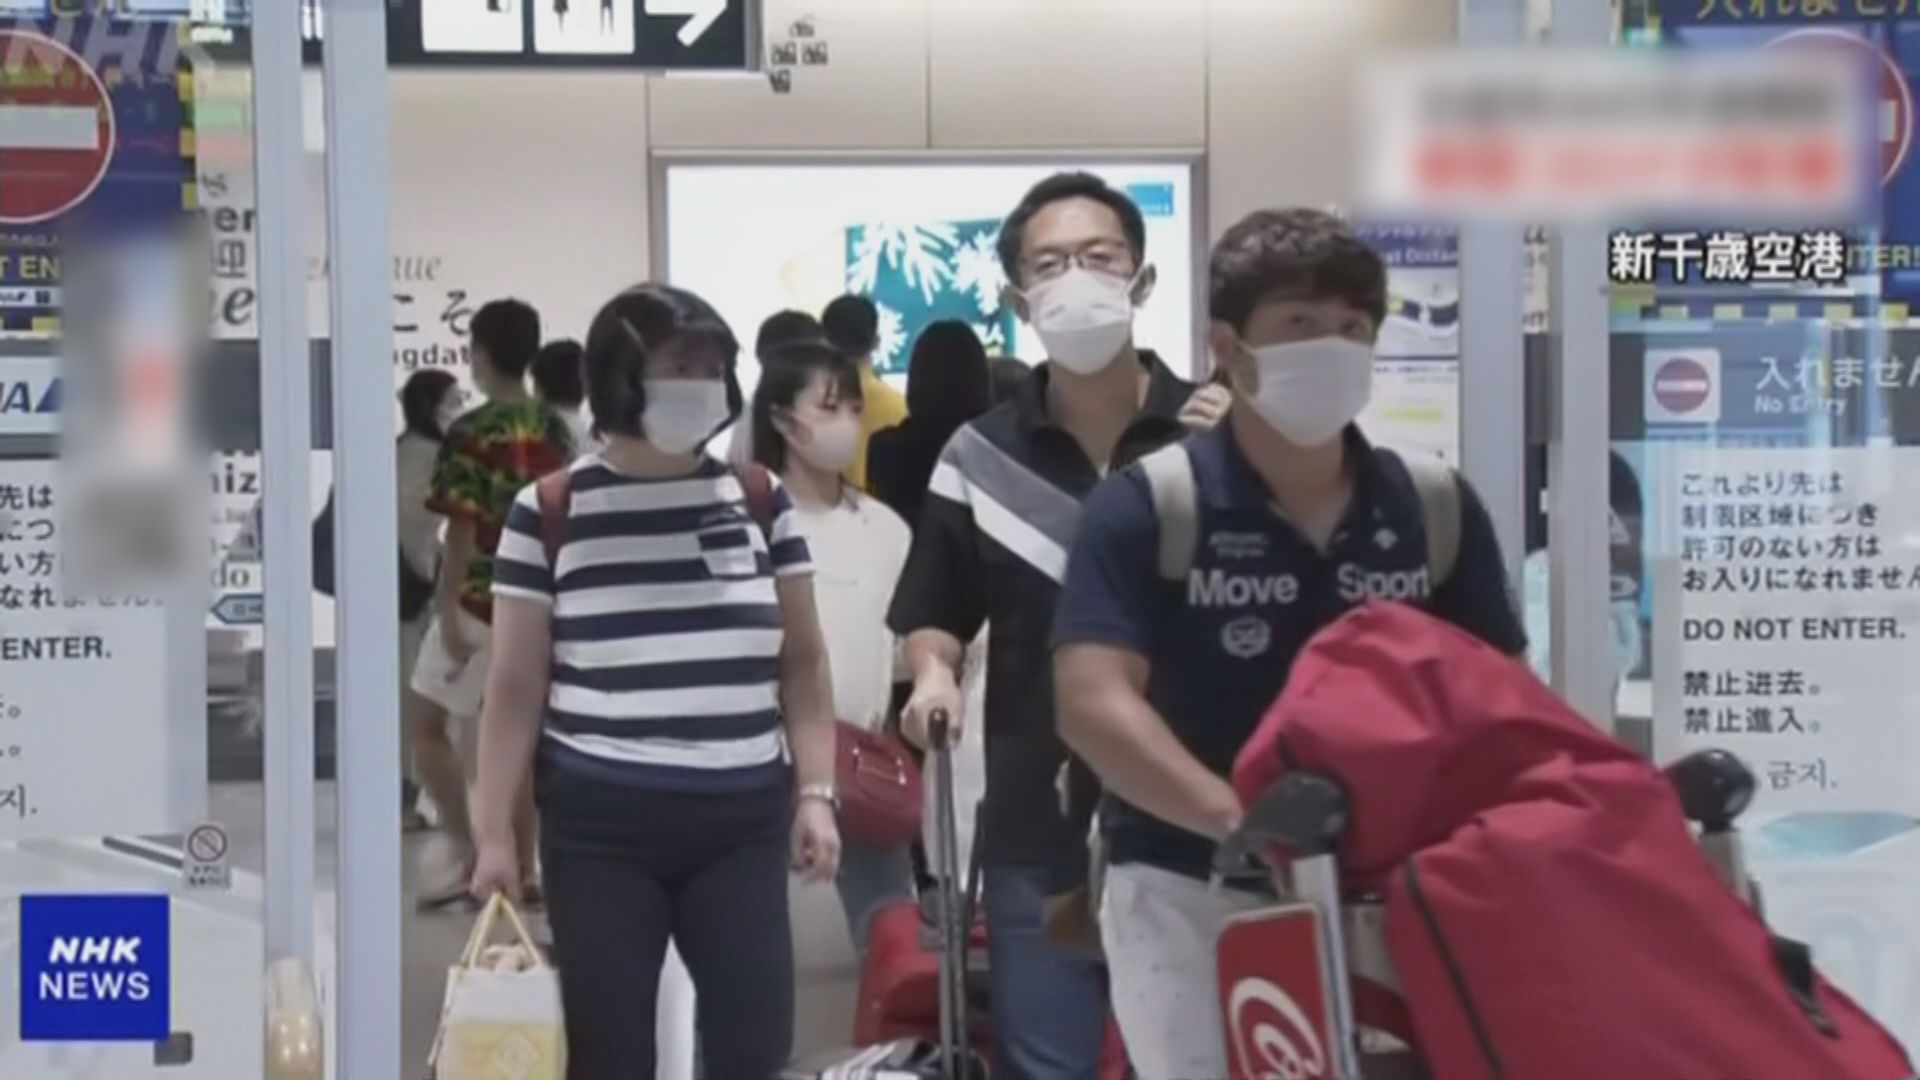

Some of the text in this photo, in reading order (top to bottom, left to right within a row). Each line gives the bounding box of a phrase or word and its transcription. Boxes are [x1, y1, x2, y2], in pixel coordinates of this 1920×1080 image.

[1682, 472, 1843, 497] これより先は
[1682, 503, 1878, 529] 制限区域につき
[1682, 535, 1880, 561] 許可のない方は
[1188, 568, 1299, 606] Move
[1683, 617, 1907, 641] DO NOT ENTER.
[2, 636, 112, 660] ENTER.
[1683, 669, 1821, 697] 禁止进去。
[1684, 706, 1821, 733] 禁止進入。
